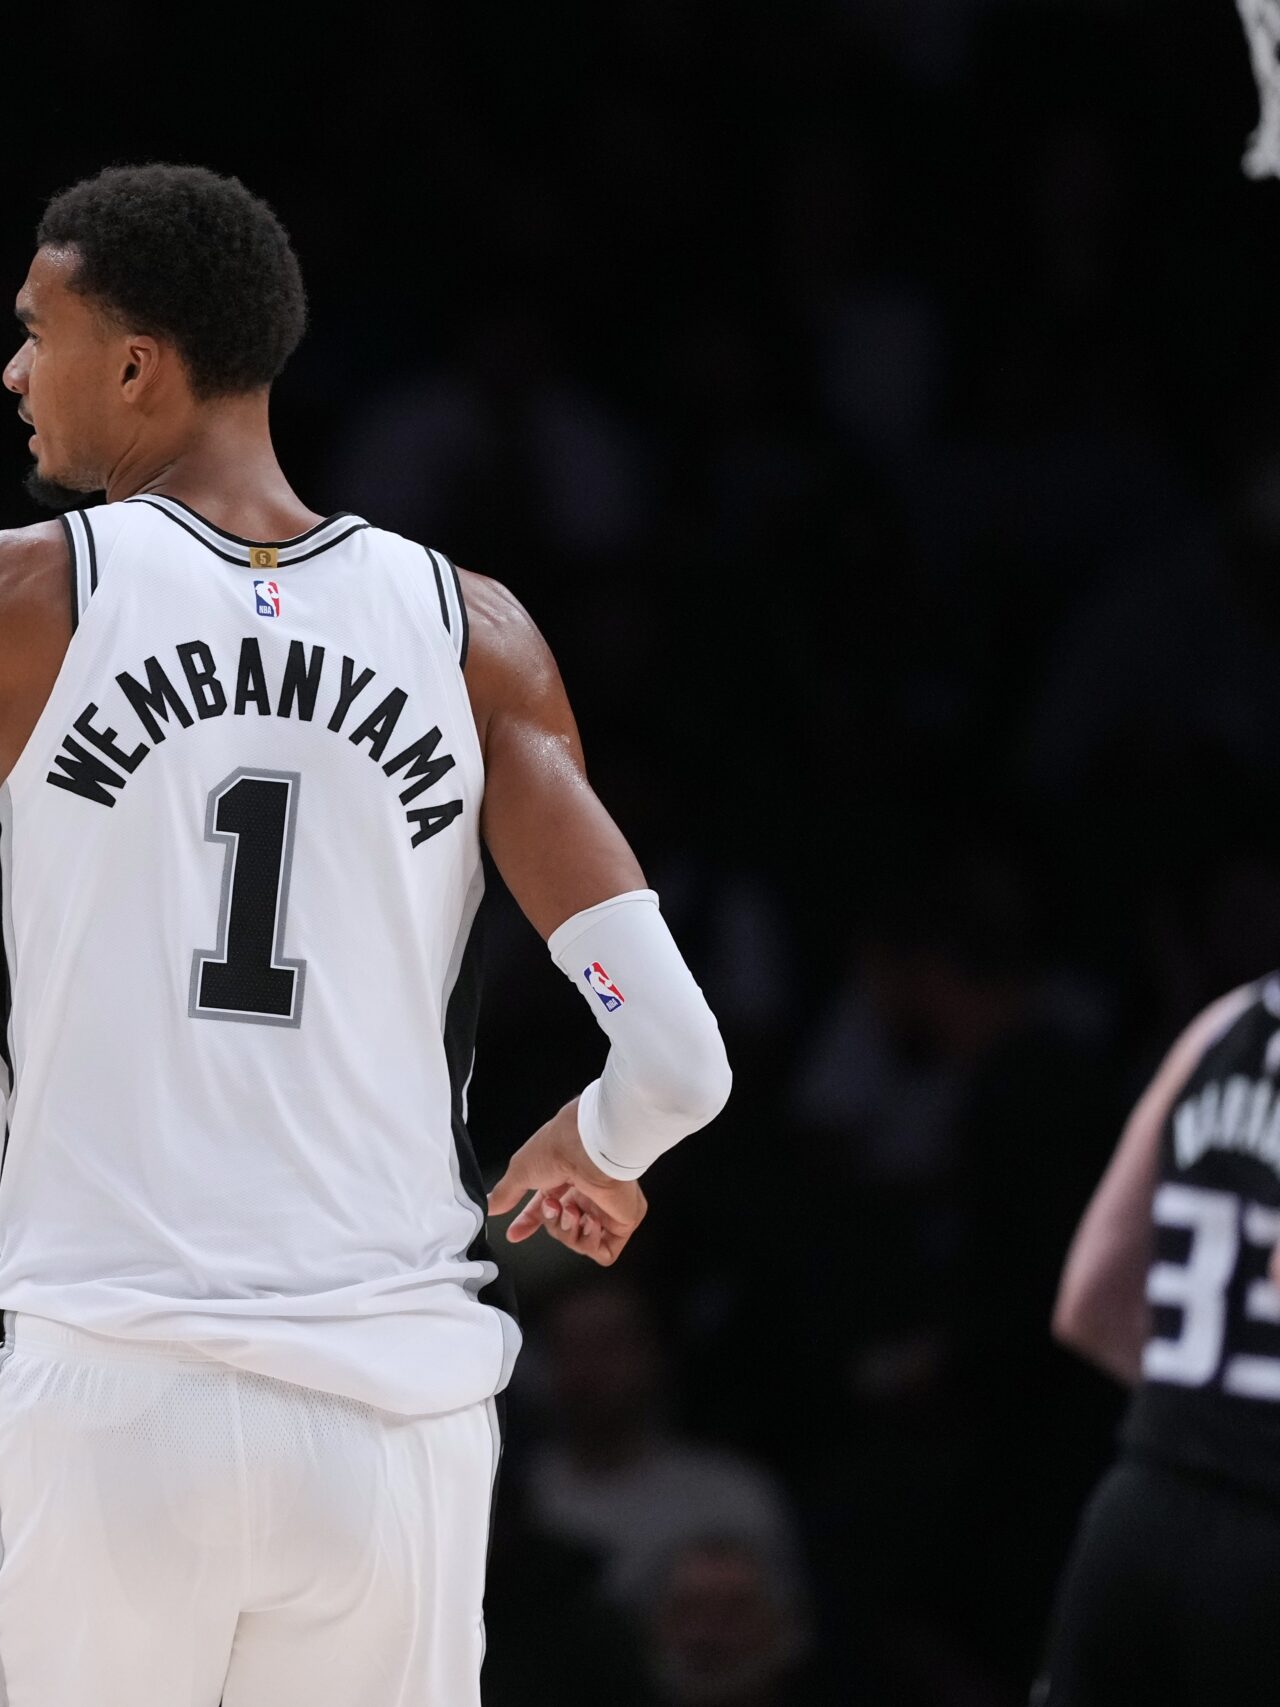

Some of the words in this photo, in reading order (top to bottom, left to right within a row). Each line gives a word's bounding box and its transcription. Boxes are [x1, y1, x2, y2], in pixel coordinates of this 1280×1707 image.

[259, 605, 272, 615] NBA
[46, 637, 463, 849] WEMBANYAMA
[188, 766, 307, 1029] 1
